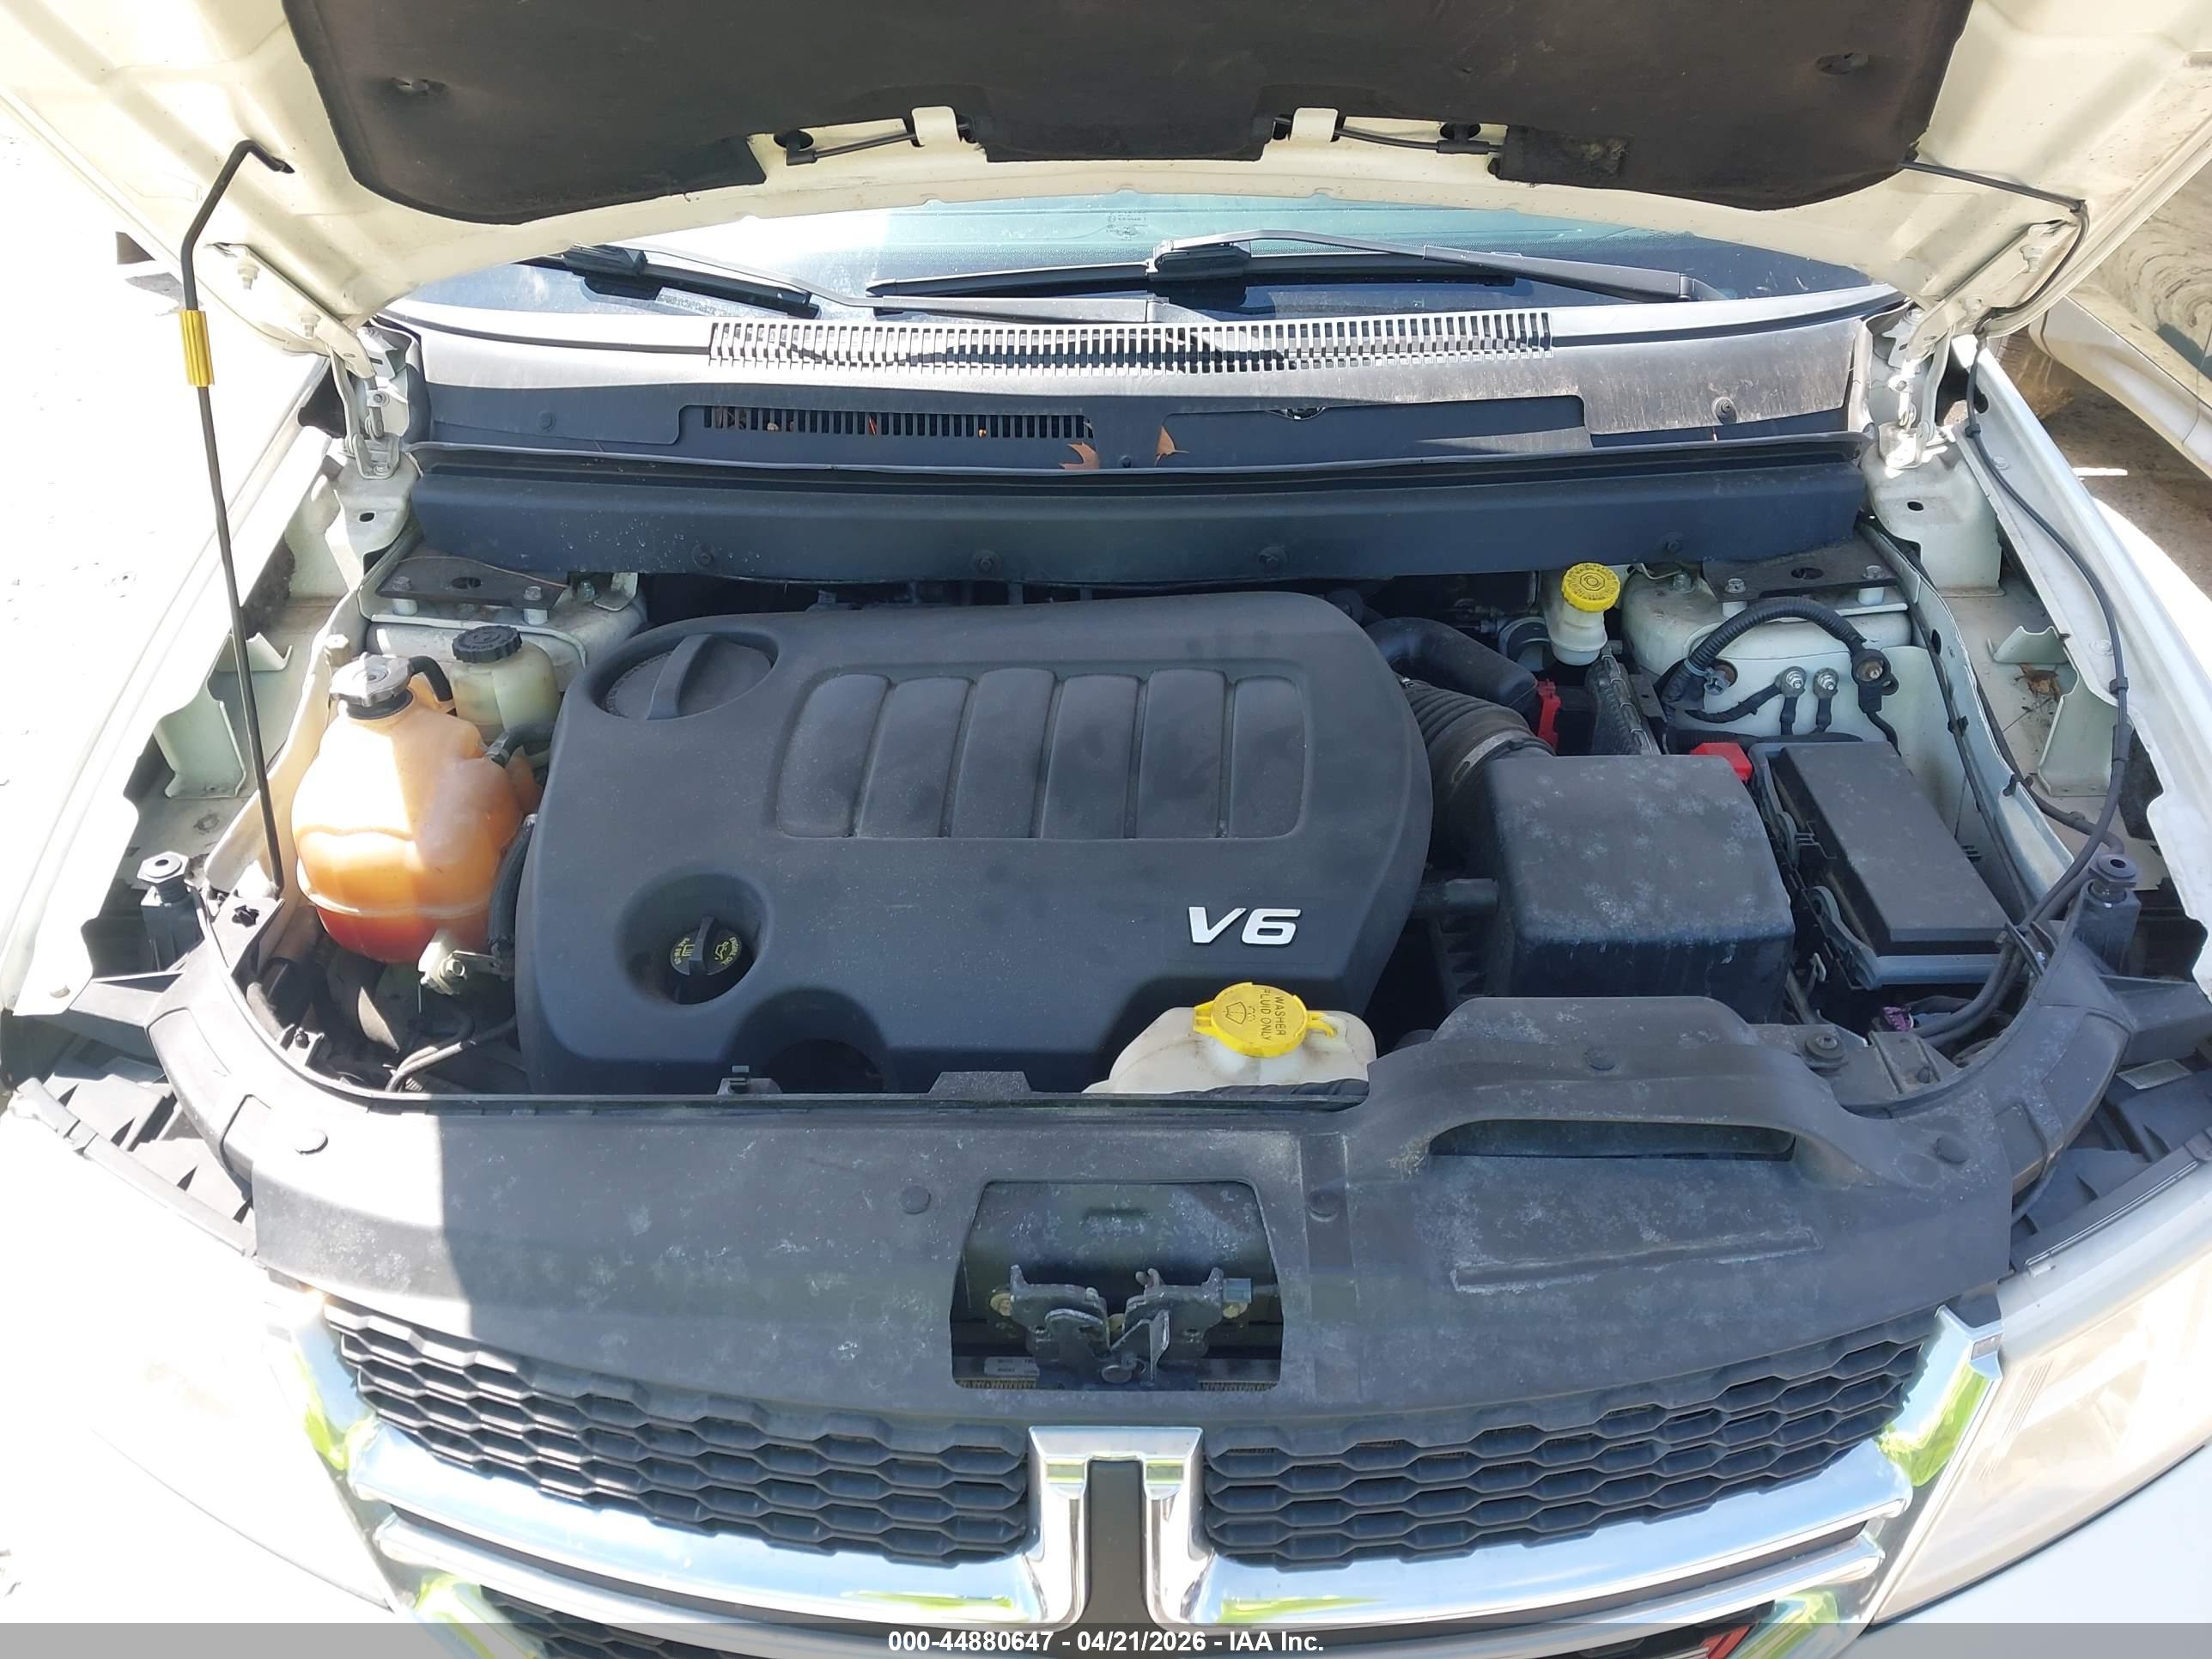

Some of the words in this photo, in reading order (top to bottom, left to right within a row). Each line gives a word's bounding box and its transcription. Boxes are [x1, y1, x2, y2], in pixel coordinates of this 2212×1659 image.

[1188, 906, 1302, 945] V6
[1260, 988, 1272, 1015] FLUID
[1274, 996, 1286, 1036] WASHER
[1260, 1017, 1272, 1042] ONLY
